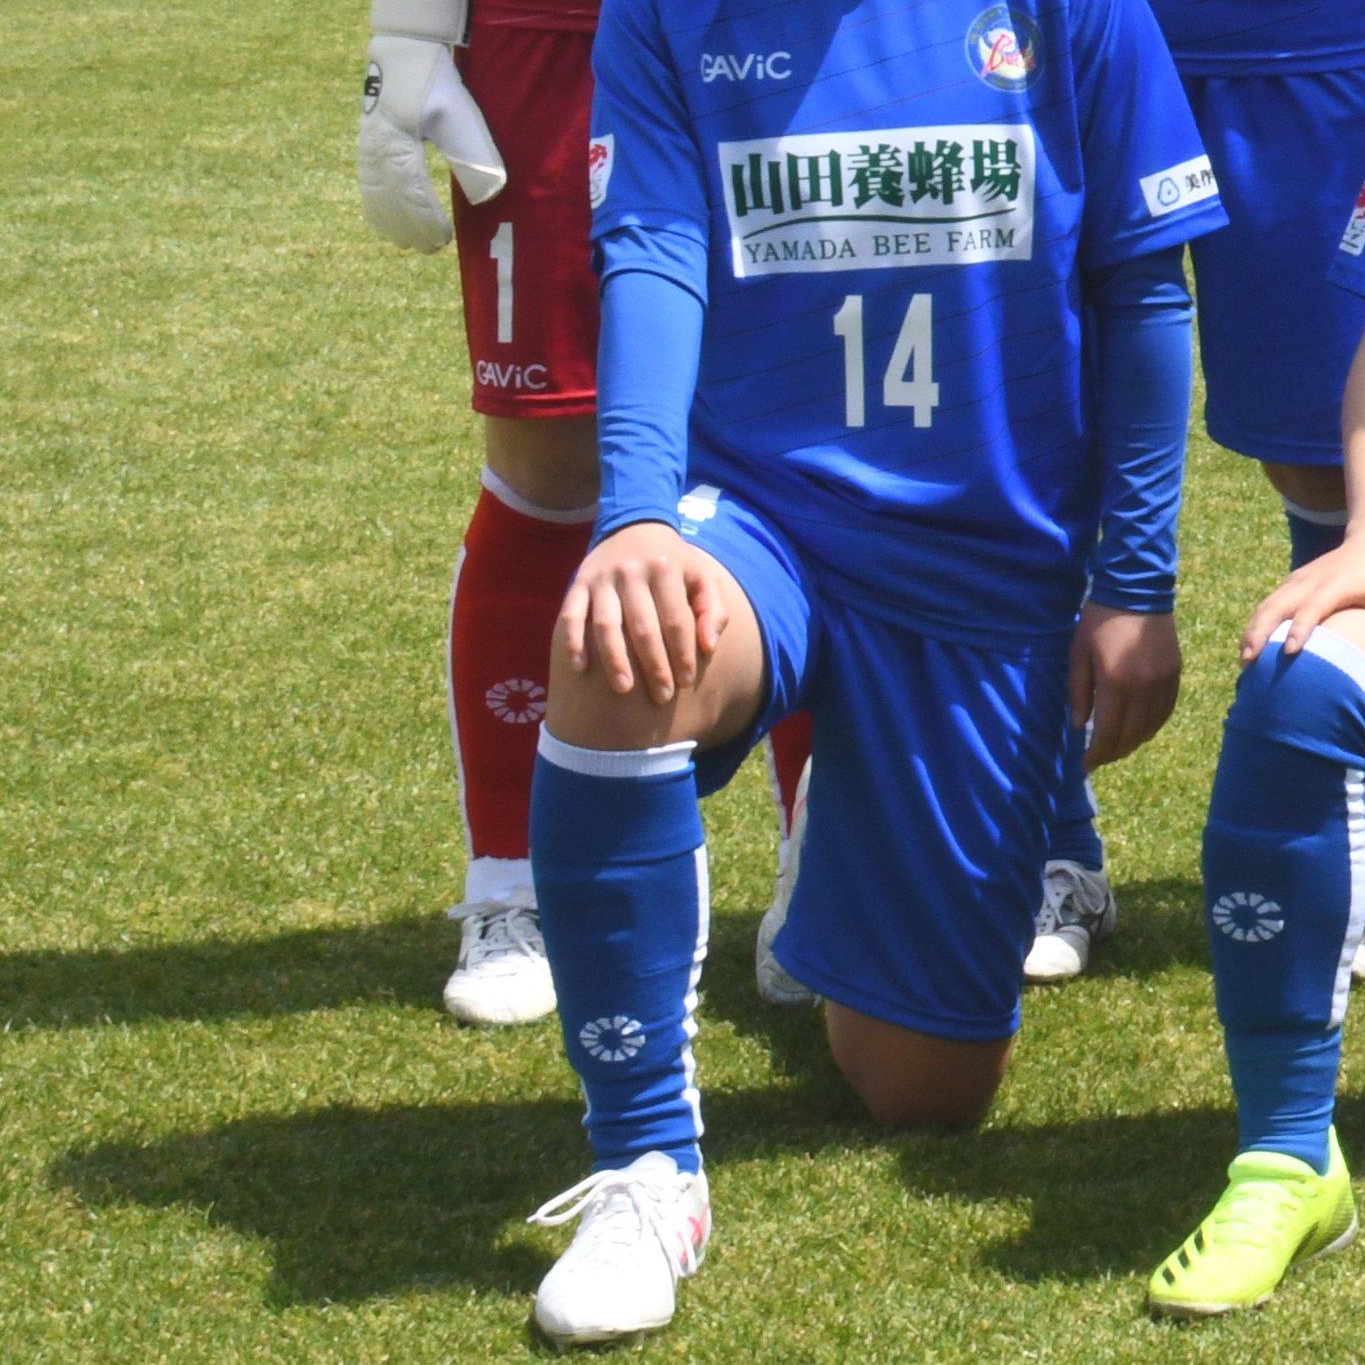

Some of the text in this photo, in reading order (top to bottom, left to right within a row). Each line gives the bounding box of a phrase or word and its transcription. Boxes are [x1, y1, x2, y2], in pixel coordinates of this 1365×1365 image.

[731, 138, 1022, 217] 山田養蜂場
[489, 221, 514, 344] 1
[744, 227, 1016, 265] YAMADA BEE FARM
[833, 292, 940, 428] 14
